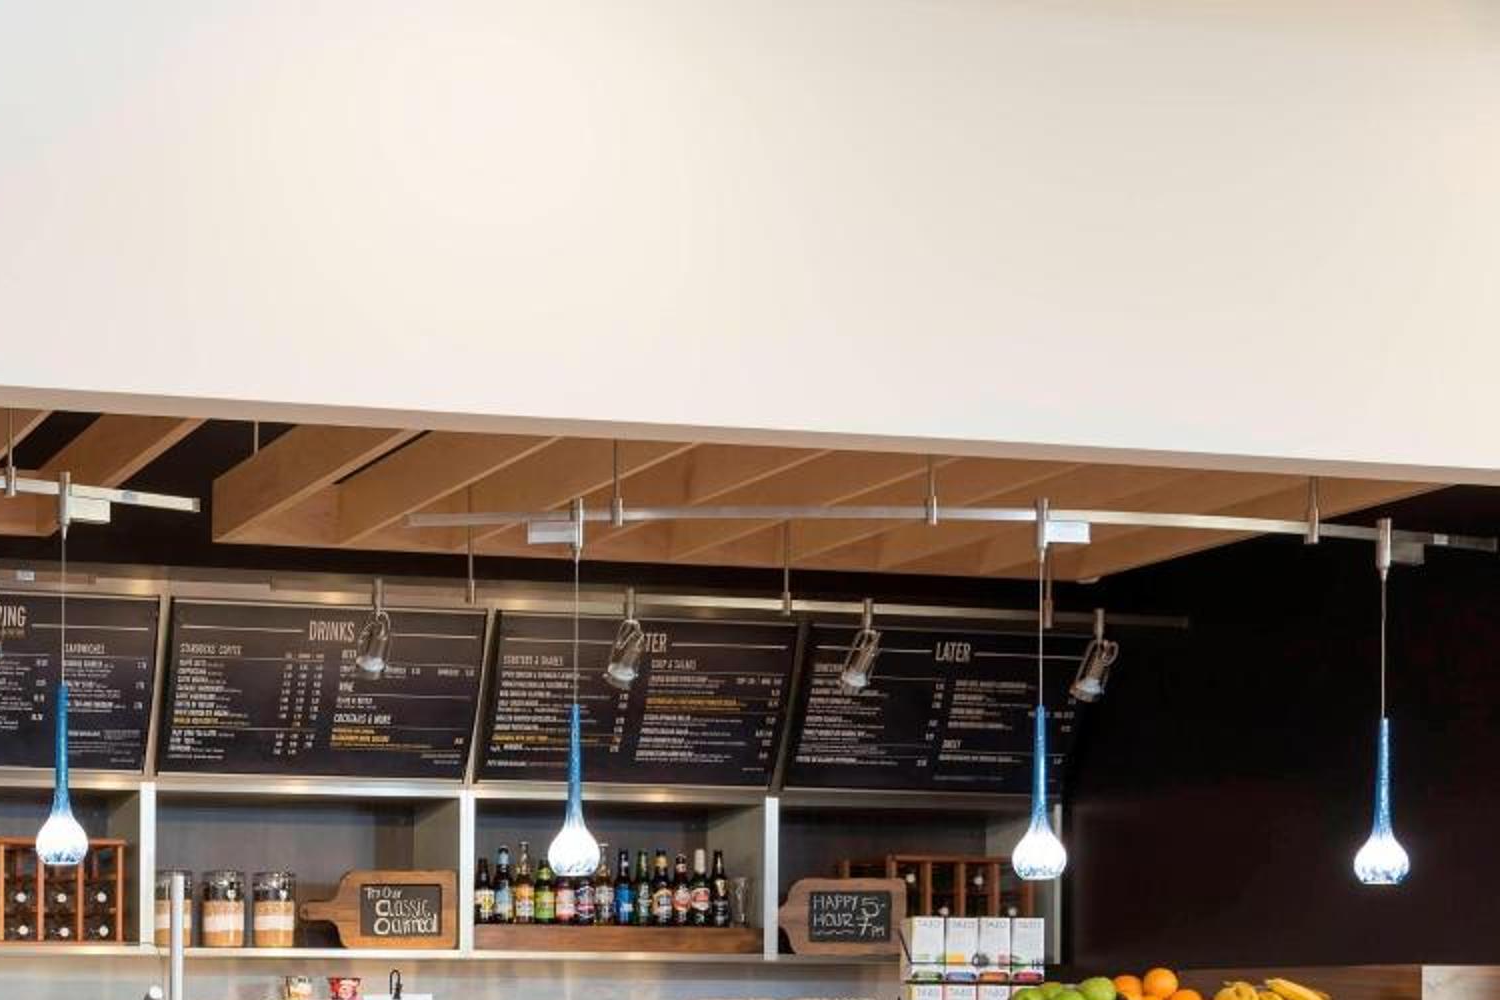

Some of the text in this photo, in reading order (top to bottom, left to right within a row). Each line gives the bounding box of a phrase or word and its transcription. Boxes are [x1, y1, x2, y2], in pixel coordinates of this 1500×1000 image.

[309, 621, 355, 642] DRINKS
[936, 642, 971, 662] LATER
[813, 895, 858, 911] HAPPY
[813, 912, 854, 928] HOUR
